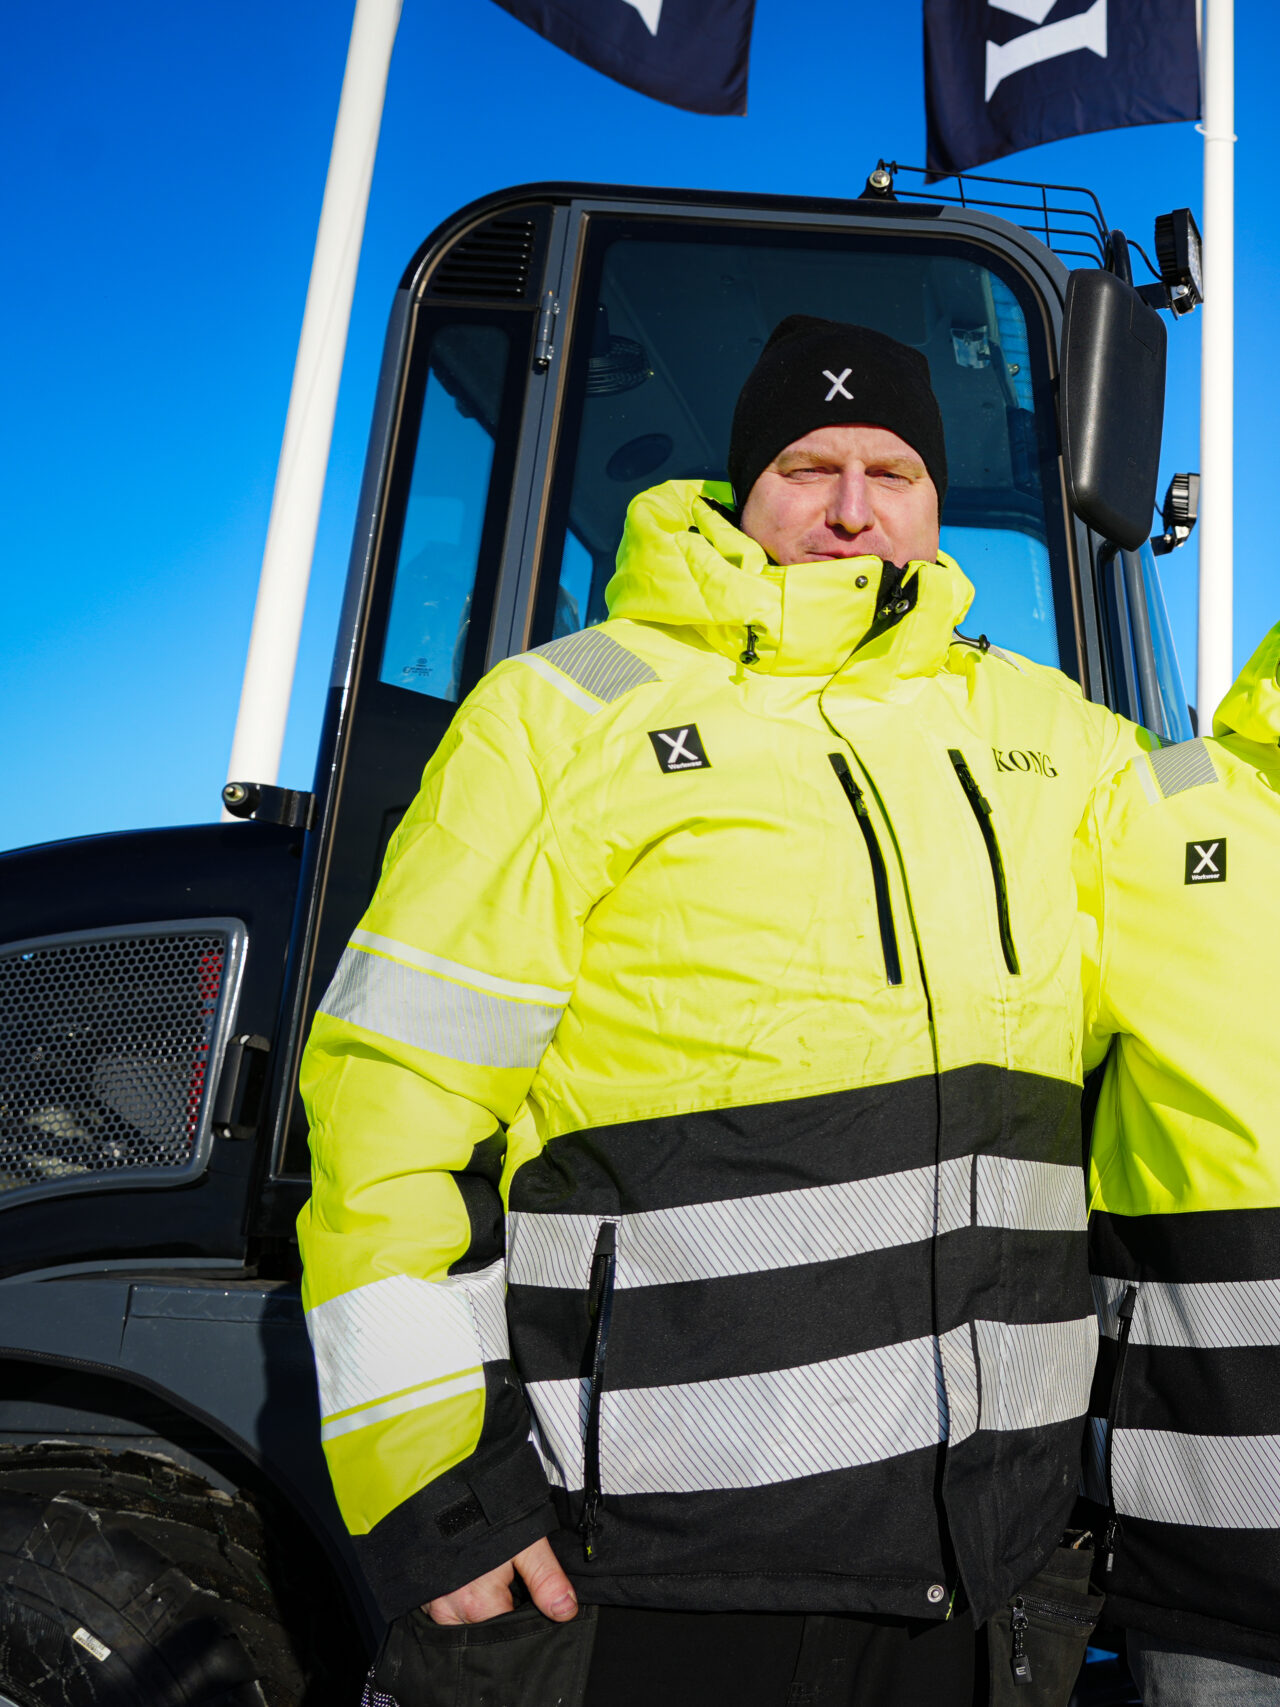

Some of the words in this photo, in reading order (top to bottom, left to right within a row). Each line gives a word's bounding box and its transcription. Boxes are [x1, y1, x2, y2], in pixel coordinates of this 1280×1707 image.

[822, 368, 855, 401] X
[657, 729, 699, 764] X
[991, 747, 1059, 778] KONG
[1193, 842, 1220, 874] X
